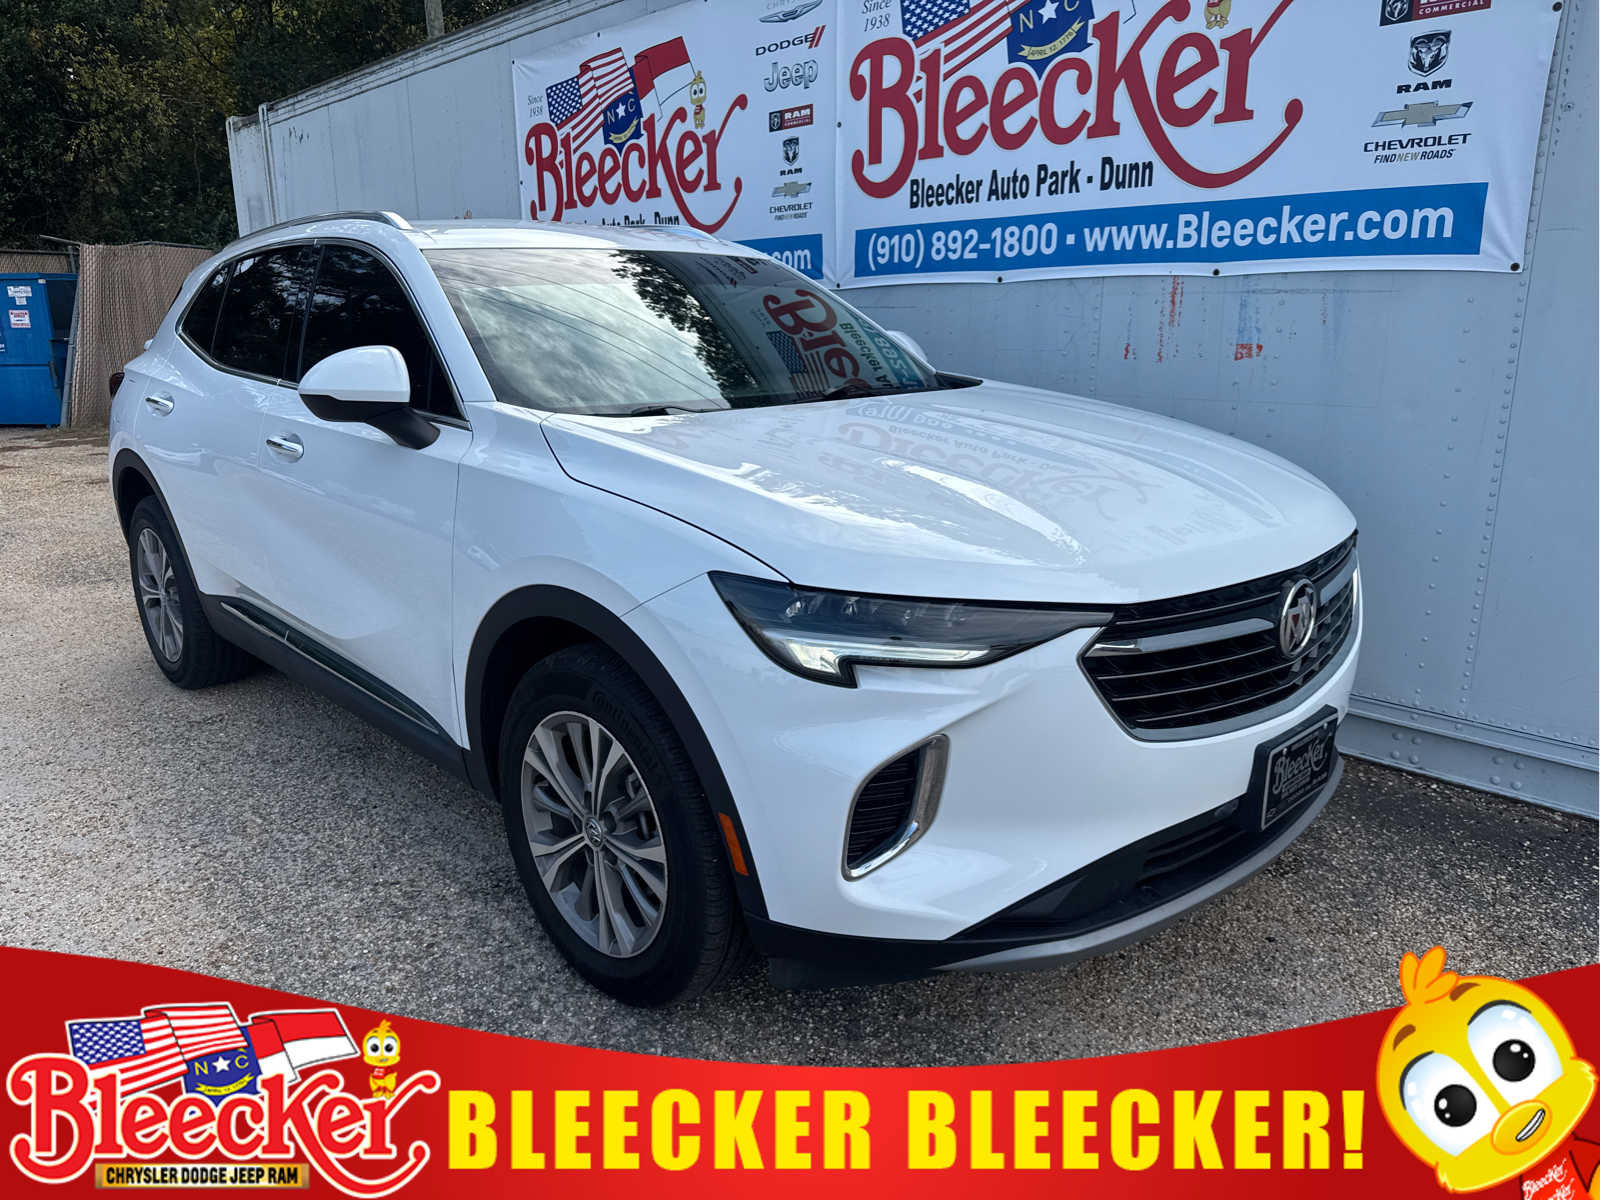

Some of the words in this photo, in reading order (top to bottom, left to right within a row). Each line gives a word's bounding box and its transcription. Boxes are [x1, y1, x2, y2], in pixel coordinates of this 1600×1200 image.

[862, 0, 892, 14] Since
[1419, 0, 1484, 15] COMMERCIAL
[864, 13, 890, 32] 1938
[1019, 10, 1034, 32] N
[756, 32, 816, 56] DODGE
[764, 60, 819, 92] Jeep
[1396, 79, 1453, 94] RAM
[849, 0, 1304, 199] Bleecker
[784, 108, 811, 120] RAM
[1363, 132, 1472, 152] CHEVROLET
[525, 93, 748, 235] Bleecker
[1374, 153, 1397, 164] FIND
[1420, 149, 1454, 161] ROADS
[780, 168, 803, 176] RAM
[909, 173, 983, 209] Bleecker
[987, 168, 1030, 202] Auto
[1036, 160, 1081, 197] Park
[1099, 156, 1154, 191] Dunn
[769, 202, 813, 214] CHEVROLET
[868, 229, 925, 271] (910)
[930, 222, 1058, 261] 892-1800
[1083, 204, 1455, 252] www.Bleecker.com
